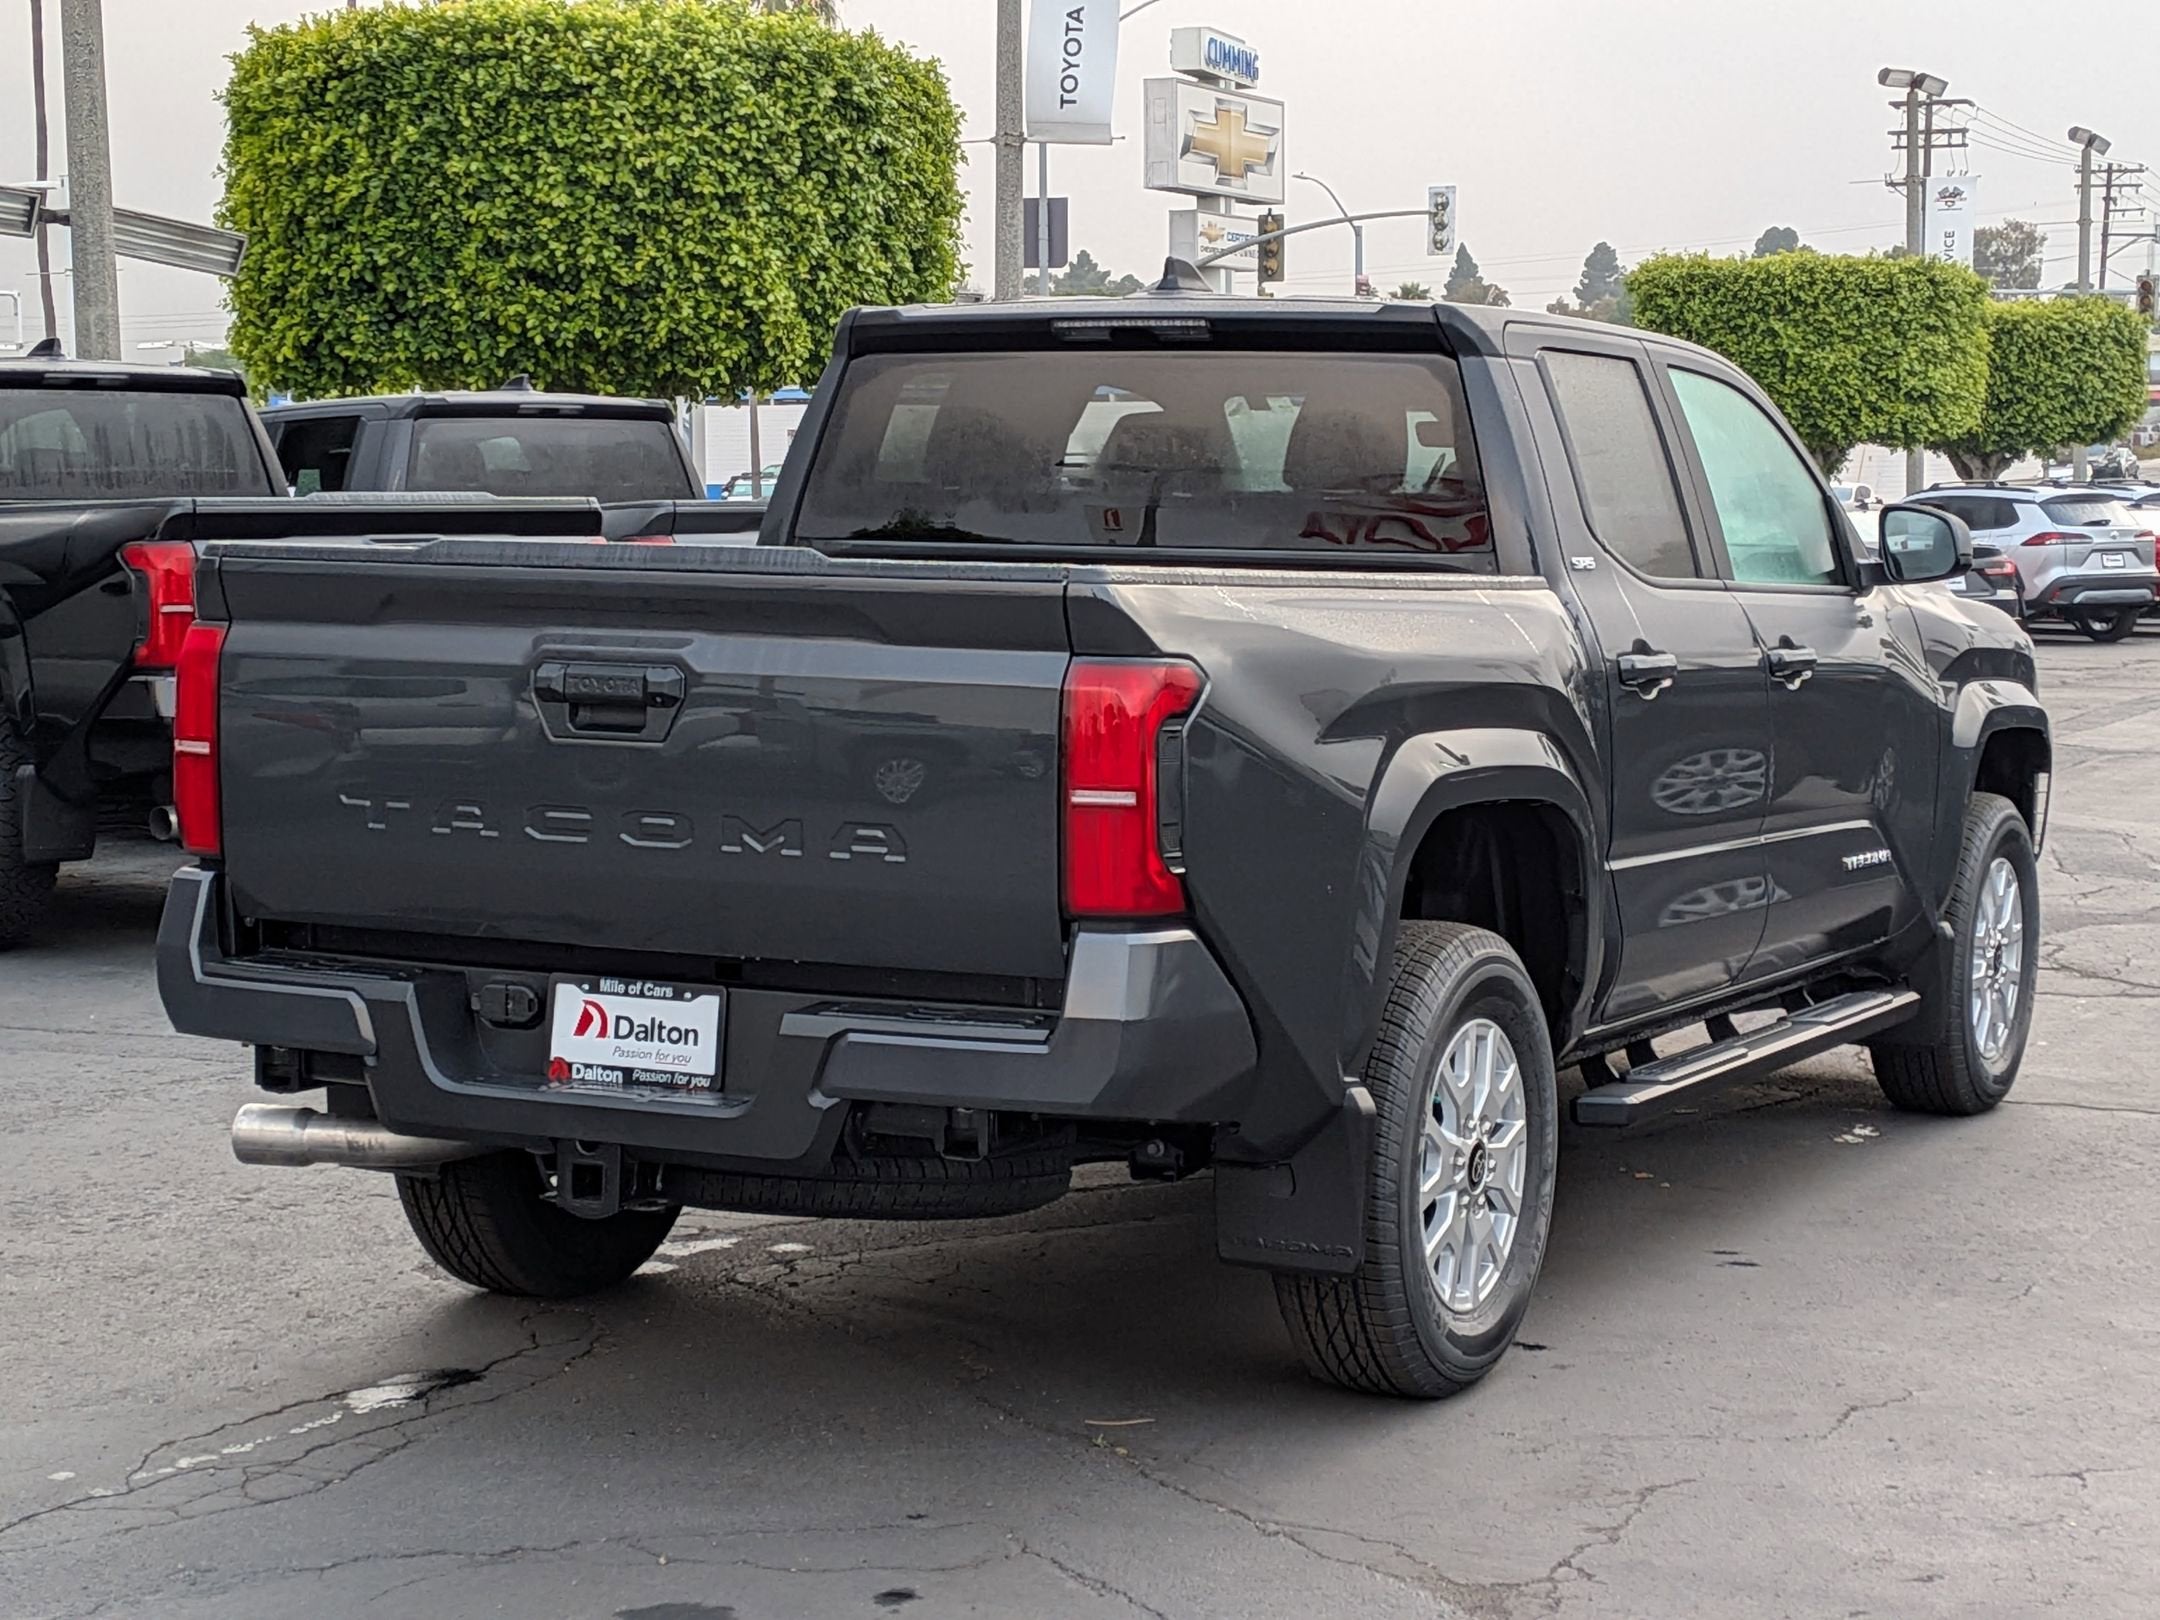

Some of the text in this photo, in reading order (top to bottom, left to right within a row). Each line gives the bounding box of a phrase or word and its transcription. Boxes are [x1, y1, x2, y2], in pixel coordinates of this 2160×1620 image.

[1060, 6, 1085, 110] TOYOTA
[566, 676, 640, 695] TOYOTA
[338, 794, 908, 863] TACOMA
[599, 976, 674, 998] Mile of Cars
[614, 1015, 699, 1047] Dalton
[612, 1046, 692, 1064] Passion for you
[571, 1063, 712, 1089] Dalton Passion for you
